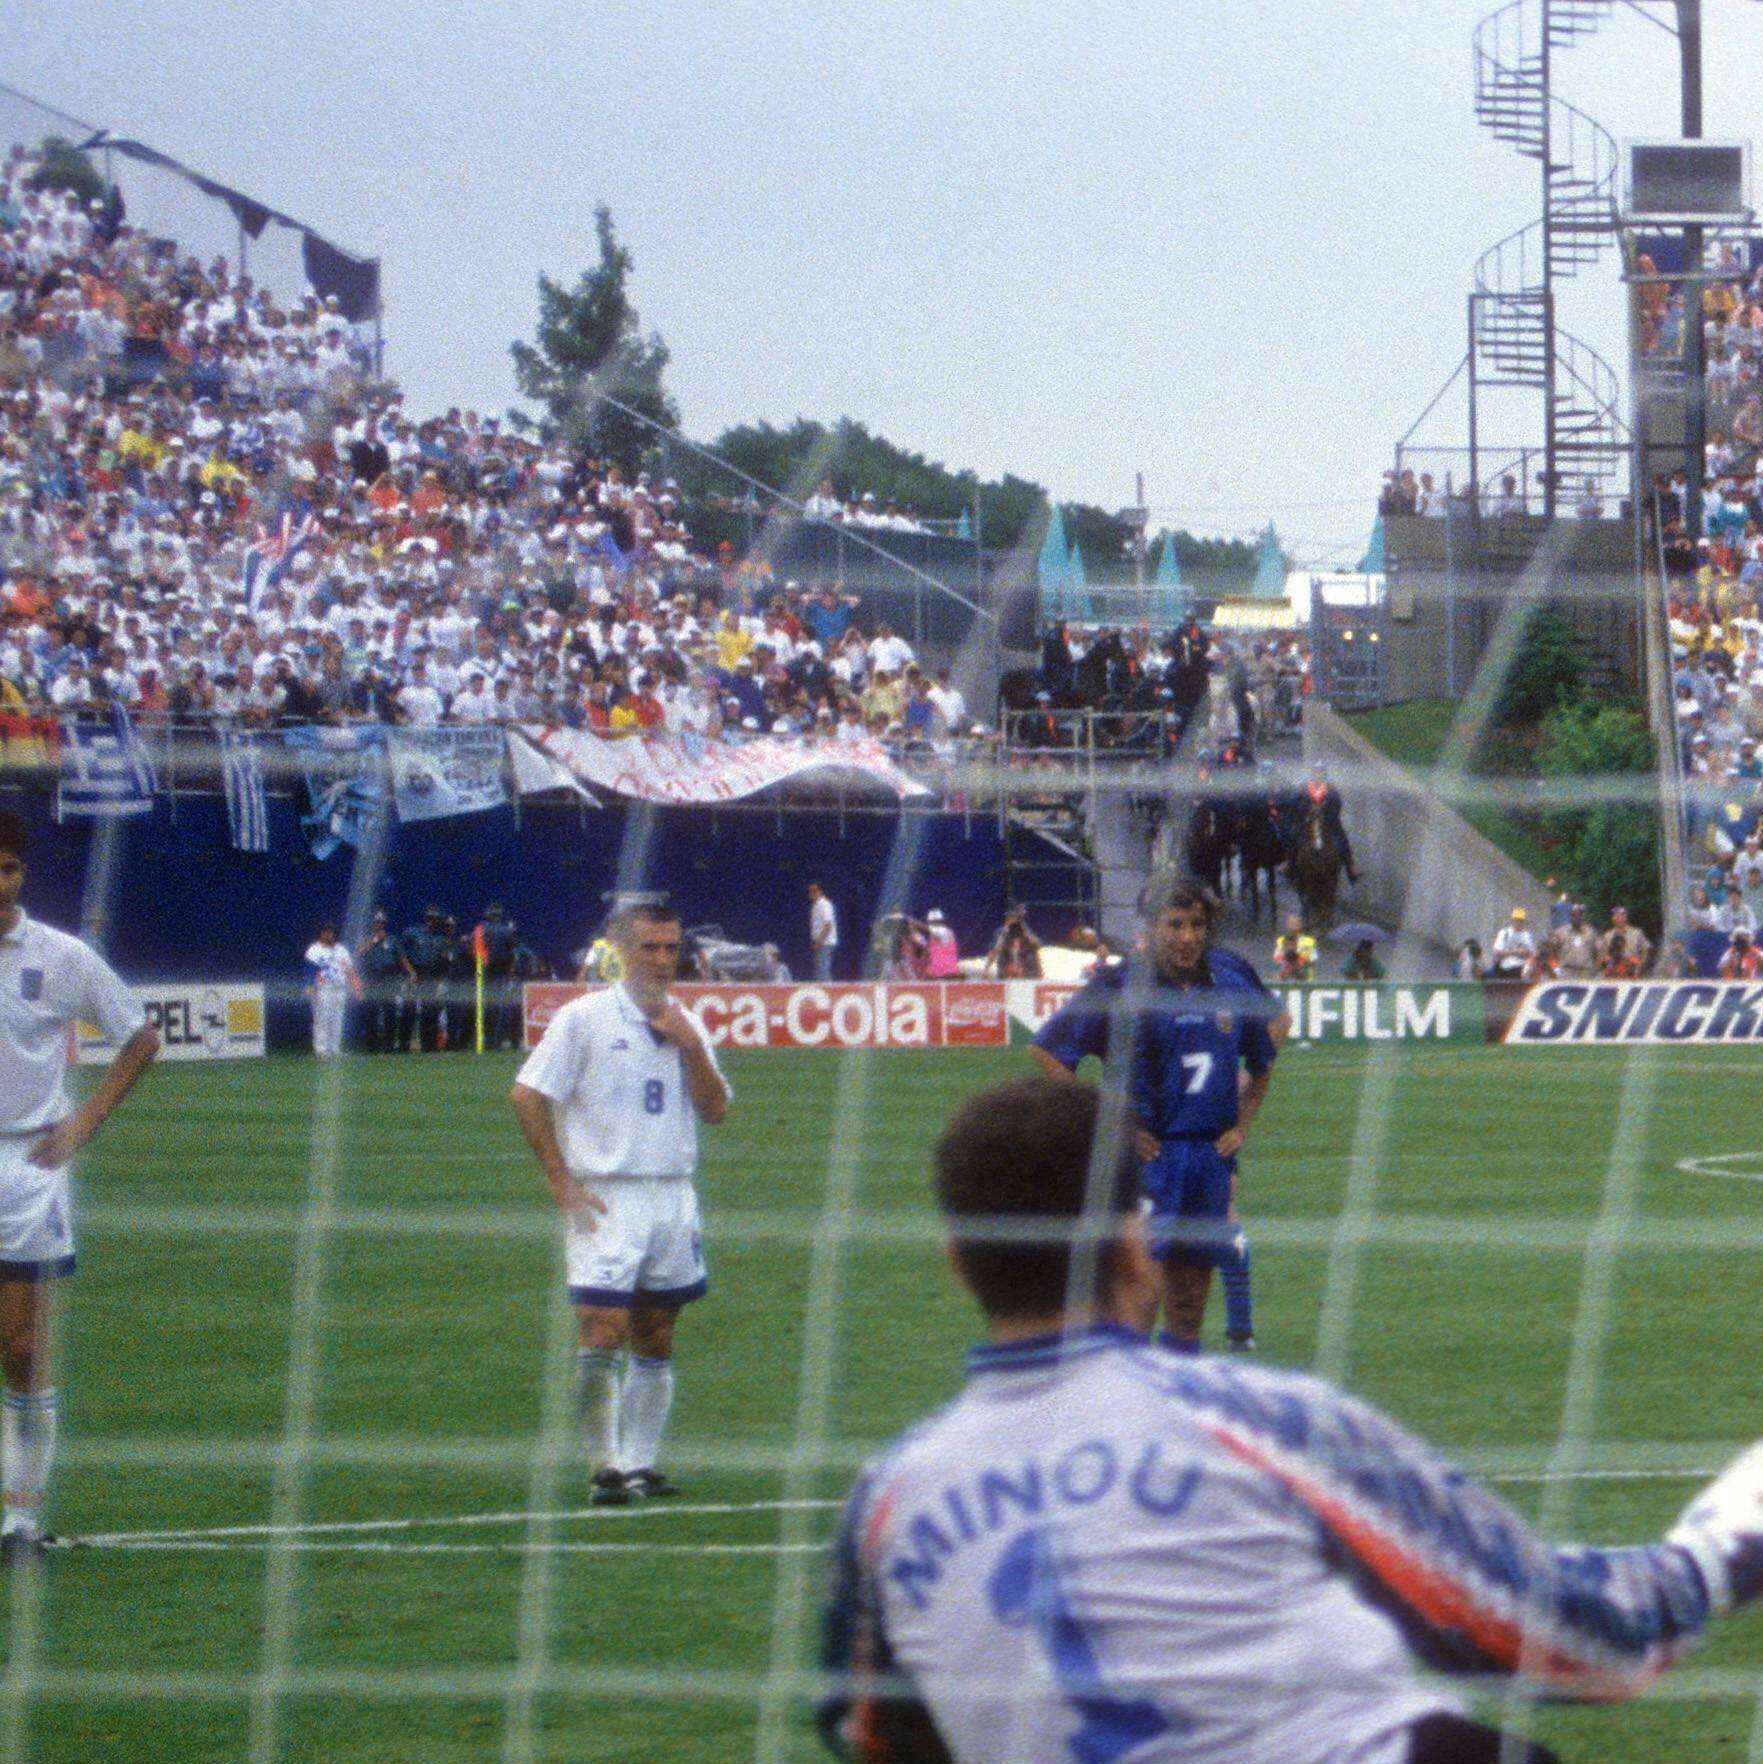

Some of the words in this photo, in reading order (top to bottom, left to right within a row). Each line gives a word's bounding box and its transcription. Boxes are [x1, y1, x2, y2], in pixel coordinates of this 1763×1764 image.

[145, 999, 202, 1044] PEL
[701, 984, 929, 1046] ca-Cola
[1182, 1053, 1213, 1094] 7
[645, 1080, 665, 1115] 8
[889, 1441, 1202, 1609] MINOU
